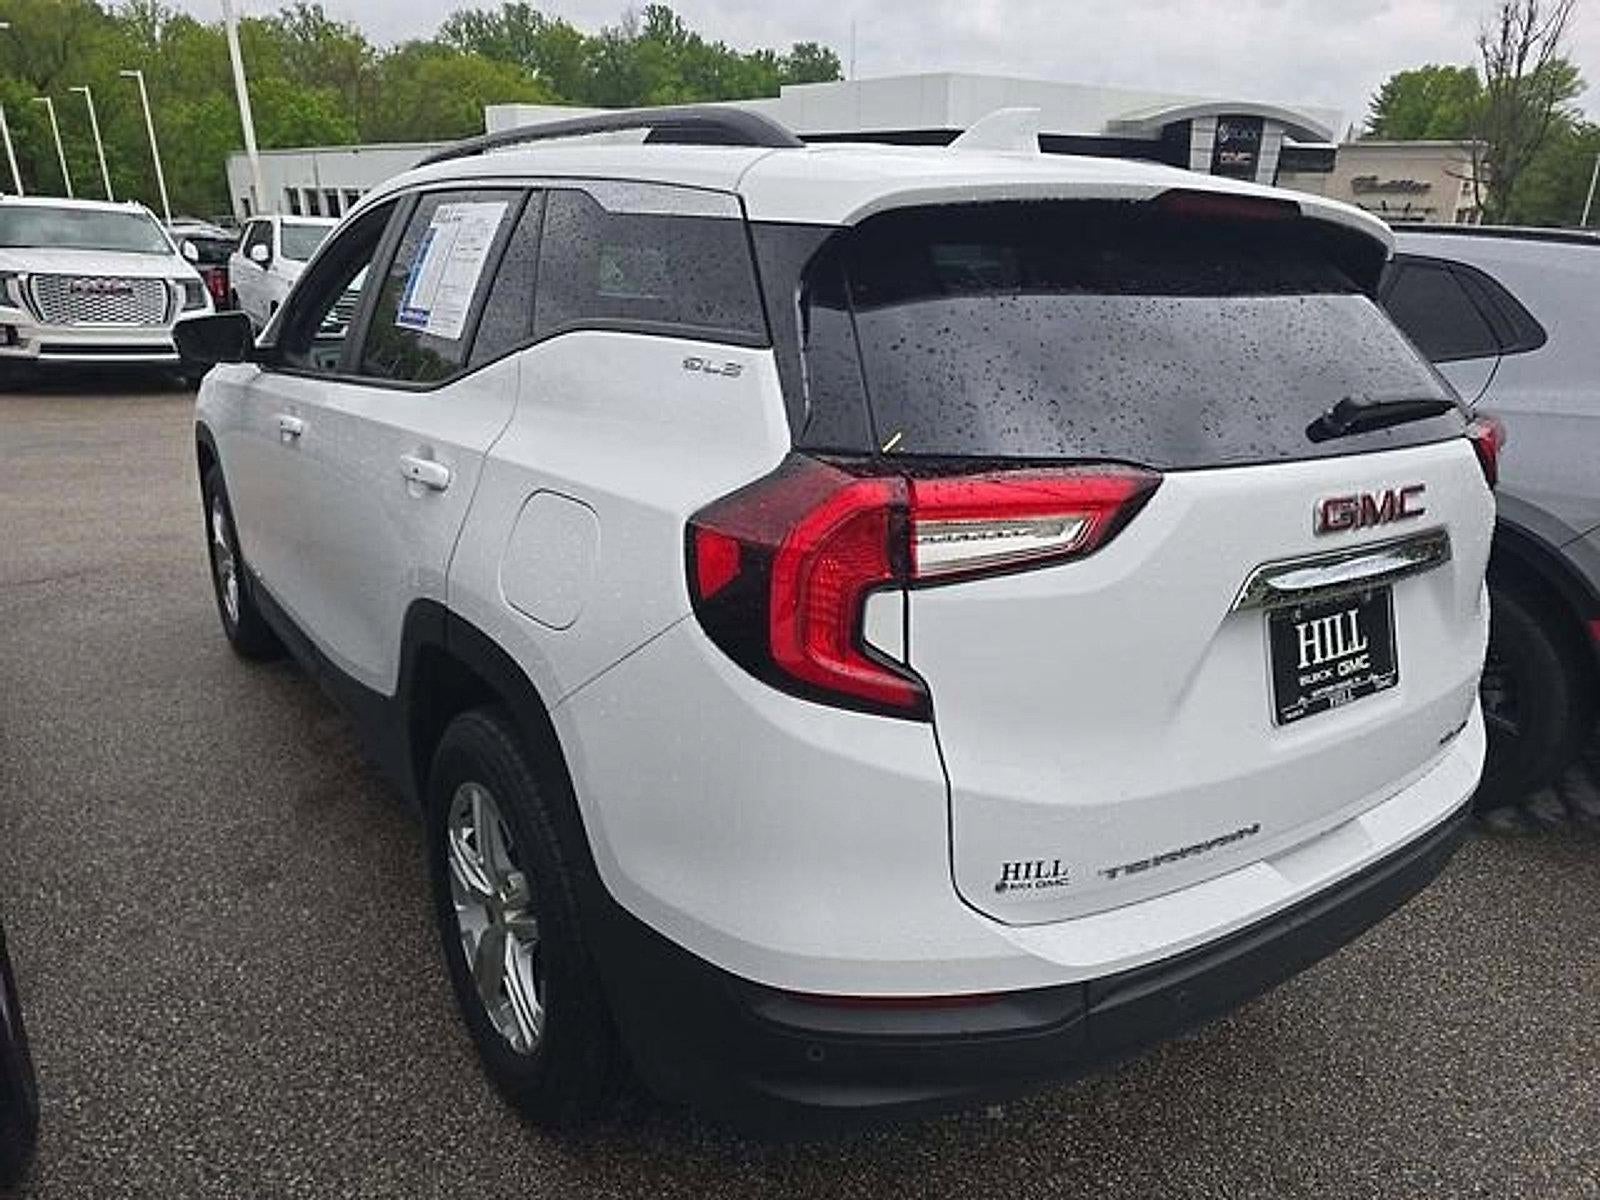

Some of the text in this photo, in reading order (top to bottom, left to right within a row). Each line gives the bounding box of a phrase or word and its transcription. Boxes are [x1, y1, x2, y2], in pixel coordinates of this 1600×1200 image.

[1314, 483, 1427, 537] GMC
[1296, 608, 1369, 669] HILL
[1337, 653, 1371, 677] GMC
[1000, 859, 1069, 881] HILL
